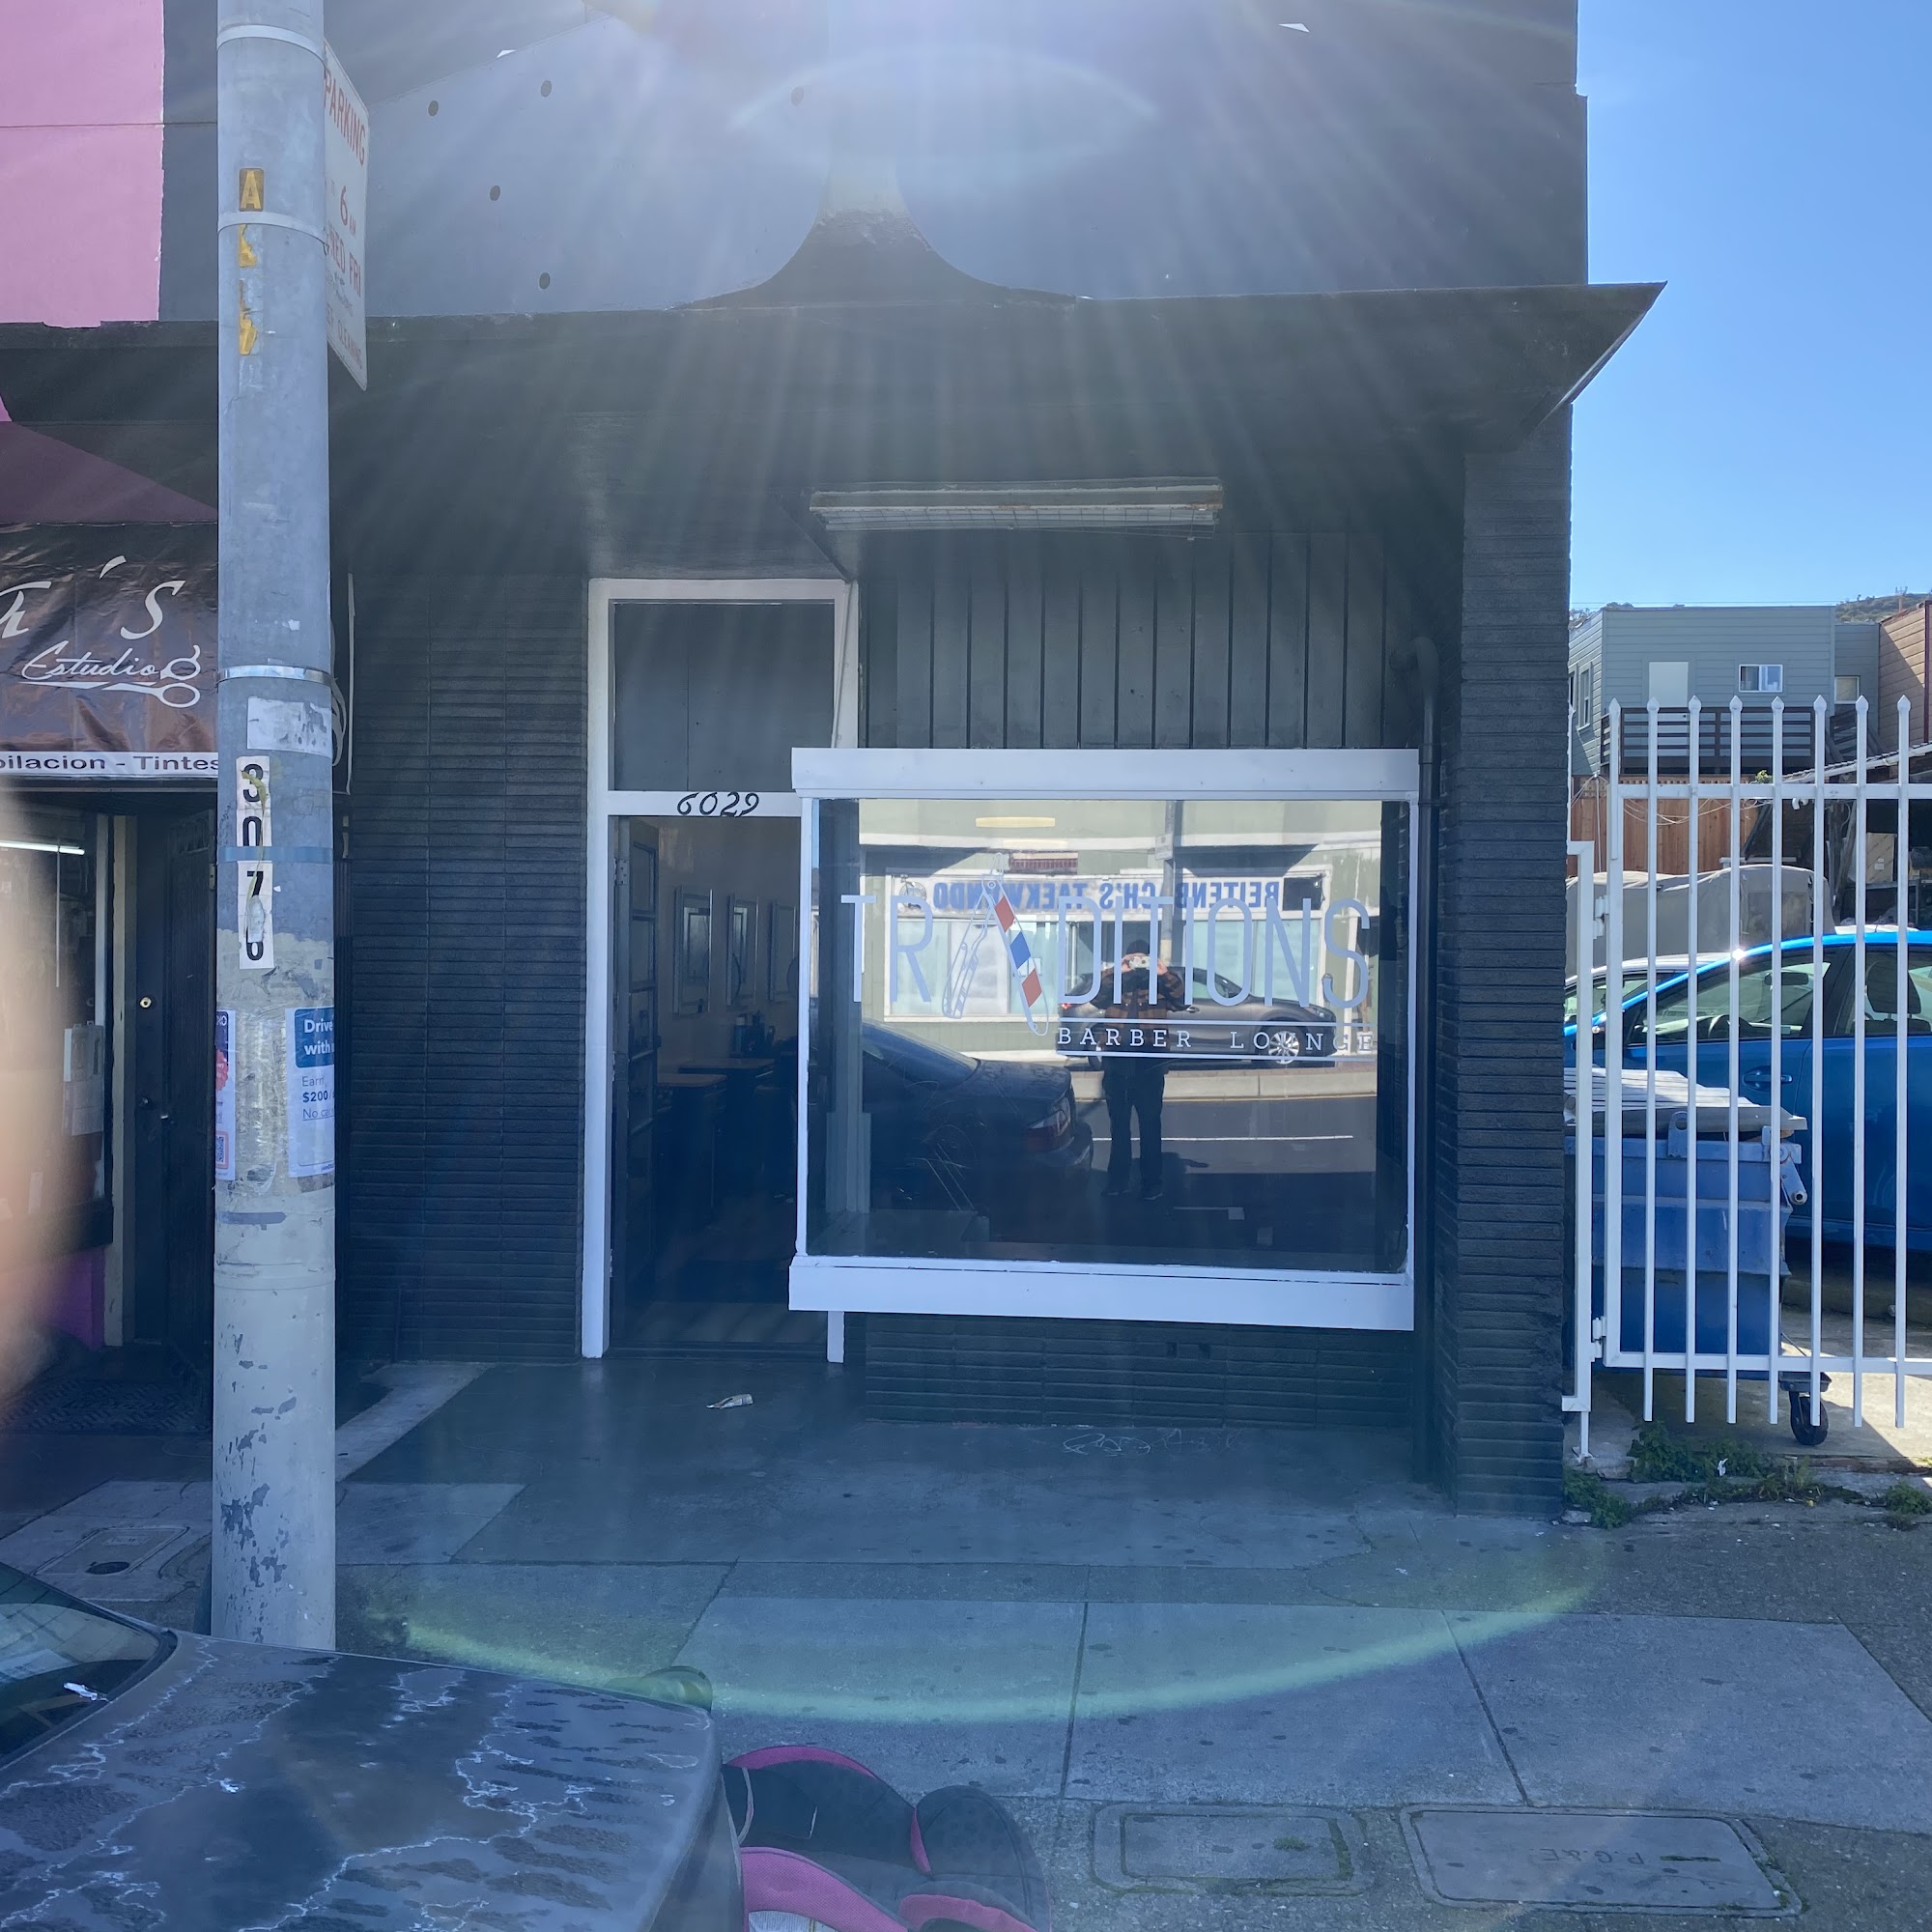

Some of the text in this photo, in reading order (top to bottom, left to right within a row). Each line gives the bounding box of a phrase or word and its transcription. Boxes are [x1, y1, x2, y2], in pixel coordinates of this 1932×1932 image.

[324, 68, 366, 166] PARKING
[241, 169, 263, 210] A
[340, 185, 349, 226] 6
[349, 252, 361, 298] FRI
[21, 640, 160, 681] Estudio
[677, 791, 759, 816] 6029
[303, 1018, 333, 1034] Drive
[303, 1039, 330, 1055] with
[1057, 1027, 1375, 1051] BARBER LOUNGE
[302, 1076, 325, 1087] Earn
[302, 1108, 319, 1120] No
